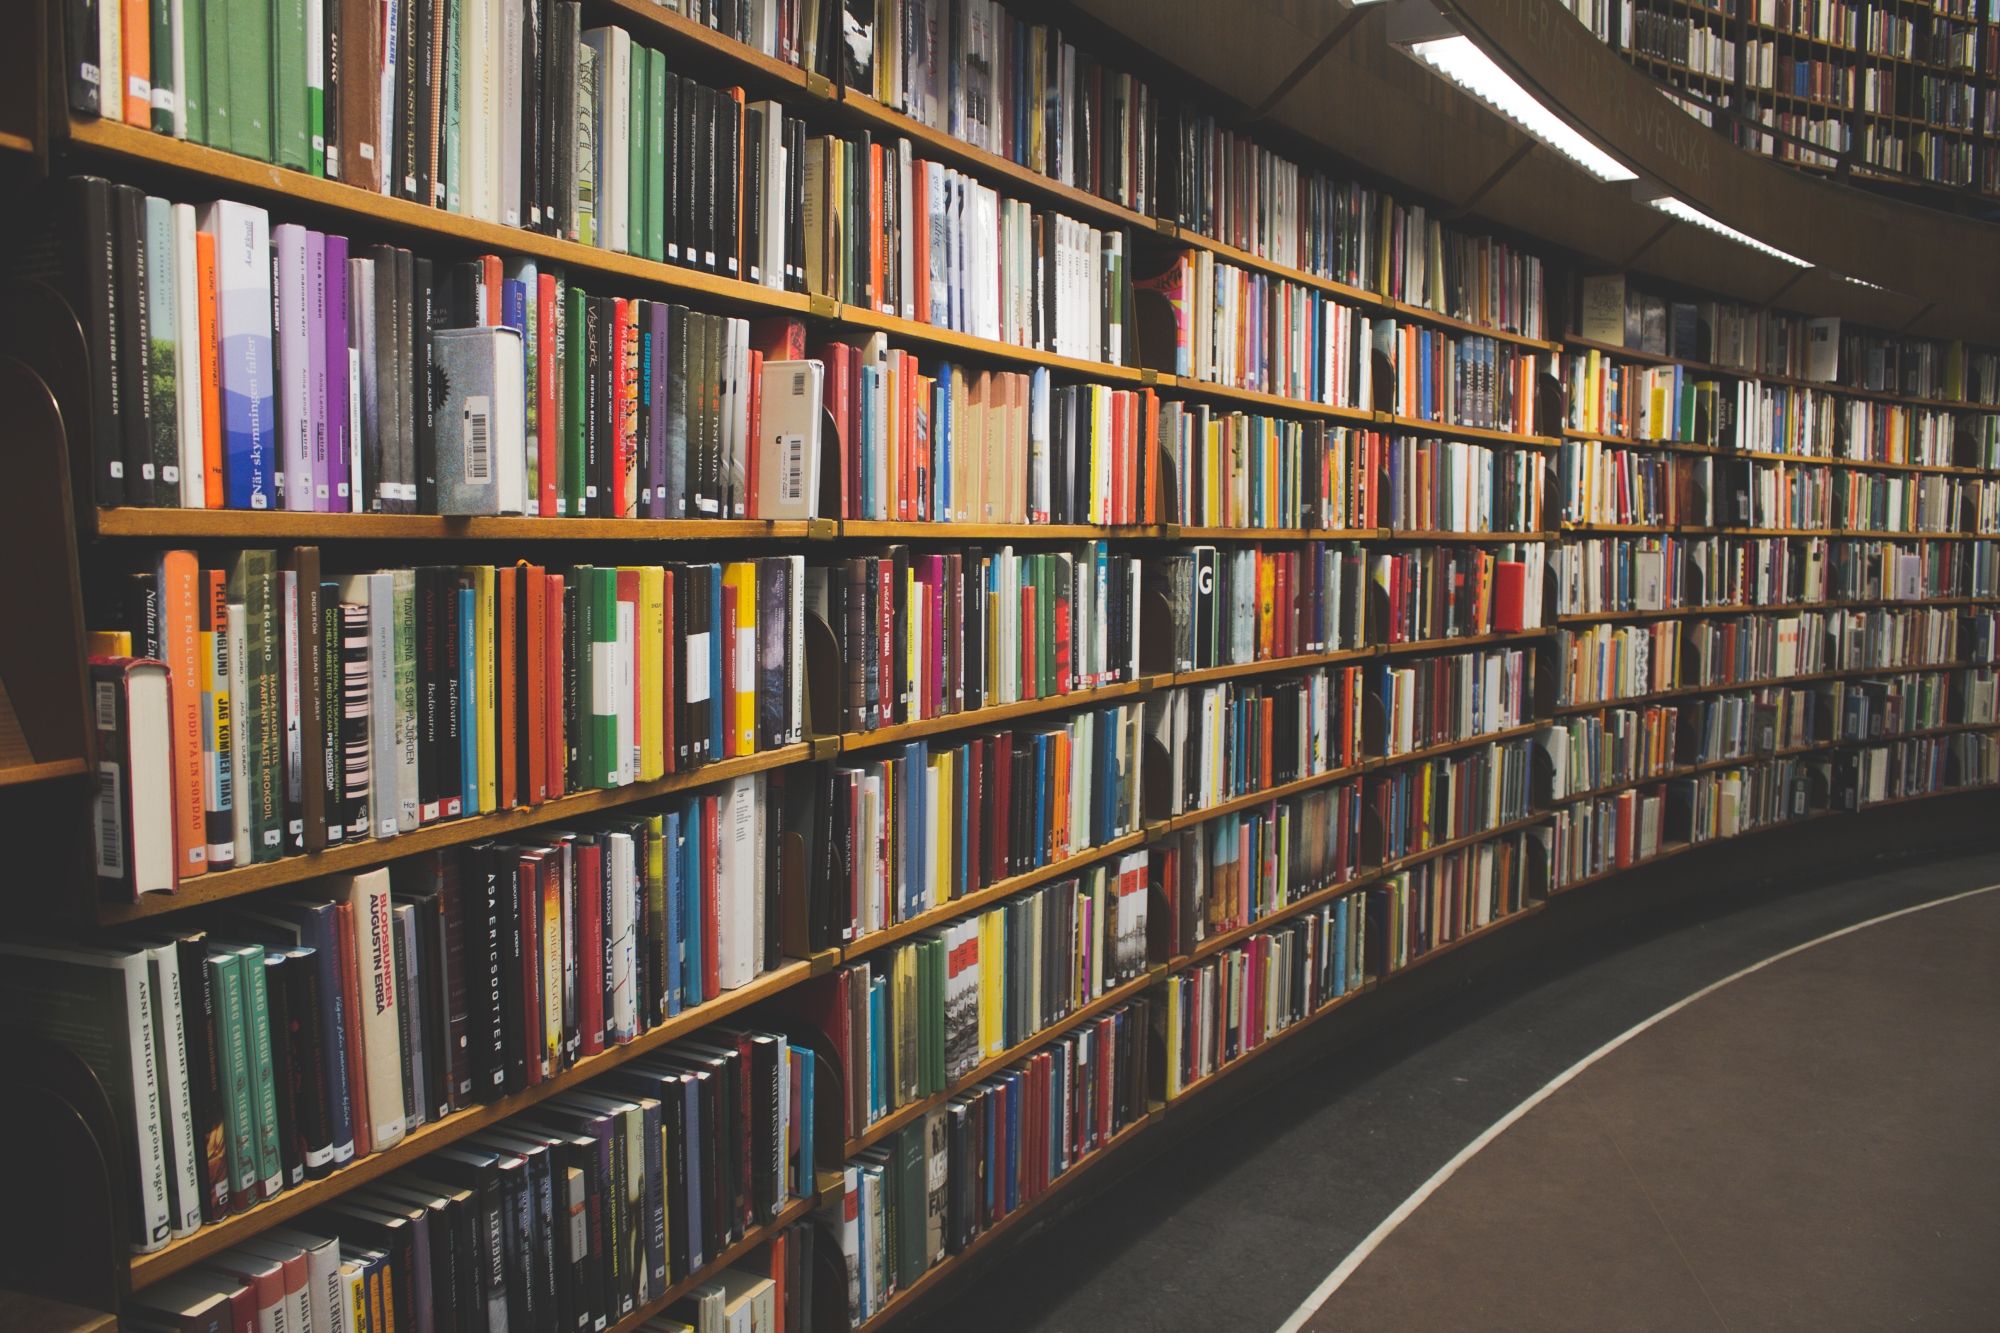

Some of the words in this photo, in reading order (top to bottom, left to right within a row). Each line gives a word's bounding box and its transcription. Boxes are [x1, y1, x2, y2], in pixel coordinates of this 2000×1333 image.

[408, 56, 416, 84] DEN
[408, 88, 416, 125] SISTA
[245, 337, 257, 374] faller
[247, 379, 262, 466] skymningen
[252, 470, 262, 496] När
[1198, 566, 1213, 595] G
[146, 588, 156, 634] Nathan
[216, 583, 227, 620] PETER
[404, 597, 414, 632] DAVIDE
[184, 614, 194, 688] ENGLUND
[217, 624, 228, 676] ENGLUND
[262, 603, 272, 662] ENGLUND
[405, 636, 414, 661] ENIA
[405, 670, 414, 684] SÅ
[218, 698, 230, 720] JAG
[406, 686, 414, 707] SOM
[449, 678, 458, 738] Bedövarna
[188, 740, 200, 759] PÅ
[220, 725, 231, 776] KOMMER
[261, 728, 270, 766] FINASTE
[327, 732, 335, 748] PER
[334, 738, 340, 752] OM
[190, 762, 200, 776] EN
[326, 749, 336, 790] ENGSTRÖM
[220, 779, 232, 806] IHÅG
[262, 768, 271, 820] KROKODIL
[370, 894, 383, 972] AUGUSTIN
[380, 892, 393, 1008] BLODSBUNDEN
[138, 980, 148, 1021] ANNE
[171, 972, 180, 1009] ANNE
[203, 980, 213, 1016] Enright
[374, 973, 386, 1016] ERBA
[488, 916, 502, 1052] ERICSDOTTER
[142, 1024, 155, 1088] ENRIGHT
[174, 1014, 186, 1076] ENRIGHT
[181, 1080, 190, 1108] Den
[232, 1024, 244, 1078] ENRIGUE
[239, 1092, 251, 1150] TIEBREAK
[258, 1016, 270, 1064] ENRIGUE
[264, 1082, 275, 1138] TIEBREAK
[148, 1092, 158, 1120] Den
[149, 1122, 162, 1162] gröna
[181, 1110, 192, 1148] gröna
[152, 1164, 164, 1202] vägen
[186, 1152, 196, 1188] vägen
[490, 1210, 502, 1286] LEKEBRUK
[327, 1270, 339, 1302] KJELL
